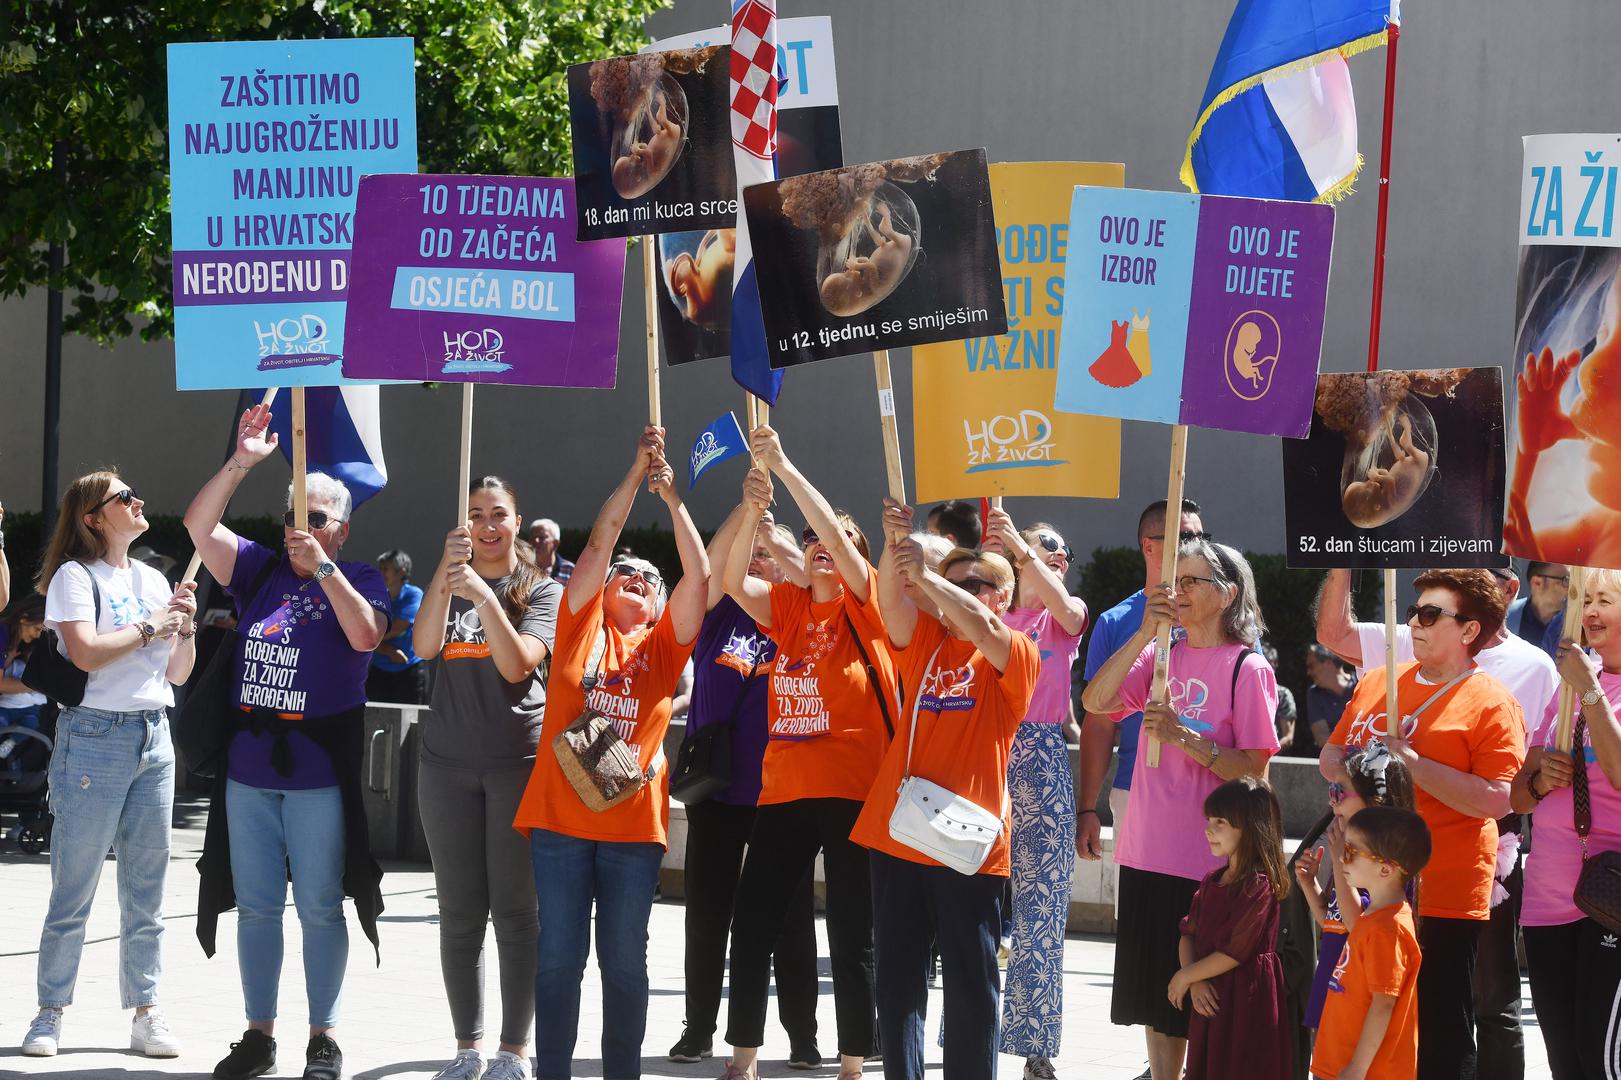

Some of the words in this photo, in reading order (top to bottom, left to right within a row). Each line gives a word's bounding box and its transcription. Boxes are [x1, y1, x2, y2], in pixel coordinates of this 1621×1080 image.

[220, 69, 360, 107] ZAŠTITIMO
[184, 114, 399, 155] NAJUGROŽENIJU
[233, 165, 353, 200] MANJINU
[1527, 166, 1563, 236] ZA
[1573, 151, 1618, 238] ŽI
[419, 184, 449, 215] 10
[457, 185, 565, 219] TJEDANA
[585, 207, 601, 226] 18.
[604, 206, 629, 224] dan
[633, 202, 650, 221] mi
[655, 201, 694, 219] kuca
[700, 200, 738, 216] srce
[207, 216, 223, 247] U
[234, 213, 353, 247] HRVATSK
[419, 227, 453, 258] OD
[460, 224, 557, 262] ZAČEĆA
[1100, 215, 1139, 246] OVO
[1144, 219, 1166, 247] JE
[1228, 225, 1270, 256] OVO
[1275, 229, 1300, 258] JE
[183, 260, 322, 295] NEROĐENU
[1101, 254, 1157, 286] IZBOR
[1225, 265, 1295, 298] DIJETE
[409, 272, 501, 308] OSJEĆA
[511, 279, 560, 312] BOL
[254, 314, 327, 348] HOD
[443, 328, 503, 353] HOD
[779, 338, 788, 351] u
[792, 331, 815, 349] 12.
[819, 324, 876, 347] tjednu
[881, 319, 903, 334] se
[908, 307, 989, 331] smiješim
[964, 317, 1056, 372] VAŽNI
[259, 342, 281, 357] ZA
[284, 340, 331, 355] ŽIVOT
[444, 350, 462, 361] ZA
[465, 351, 505, 363] ŽIVOT
[963, 409, 1052, 452] HOD
[968, 446, 991, 465] ZA
[996, 444, 1057, 462] ŽIVOT
[1299, 536, 1321, 553] 52.
[1325, 536, 1353, 553] dan
[1358, 535, 1415, 553] štucam
[1420, 536, 1424, 553] i
[1429, 536, 1493, 557] zijevam
[244, 640, 300, 667] ROĐENIH
[243, 661, 257, 682] ZA
[773, 676, 819, 696] ROĐENIH
[240, 683, 306, 711] NEROĐENIH
[777, 697, 793, 717] ZA
